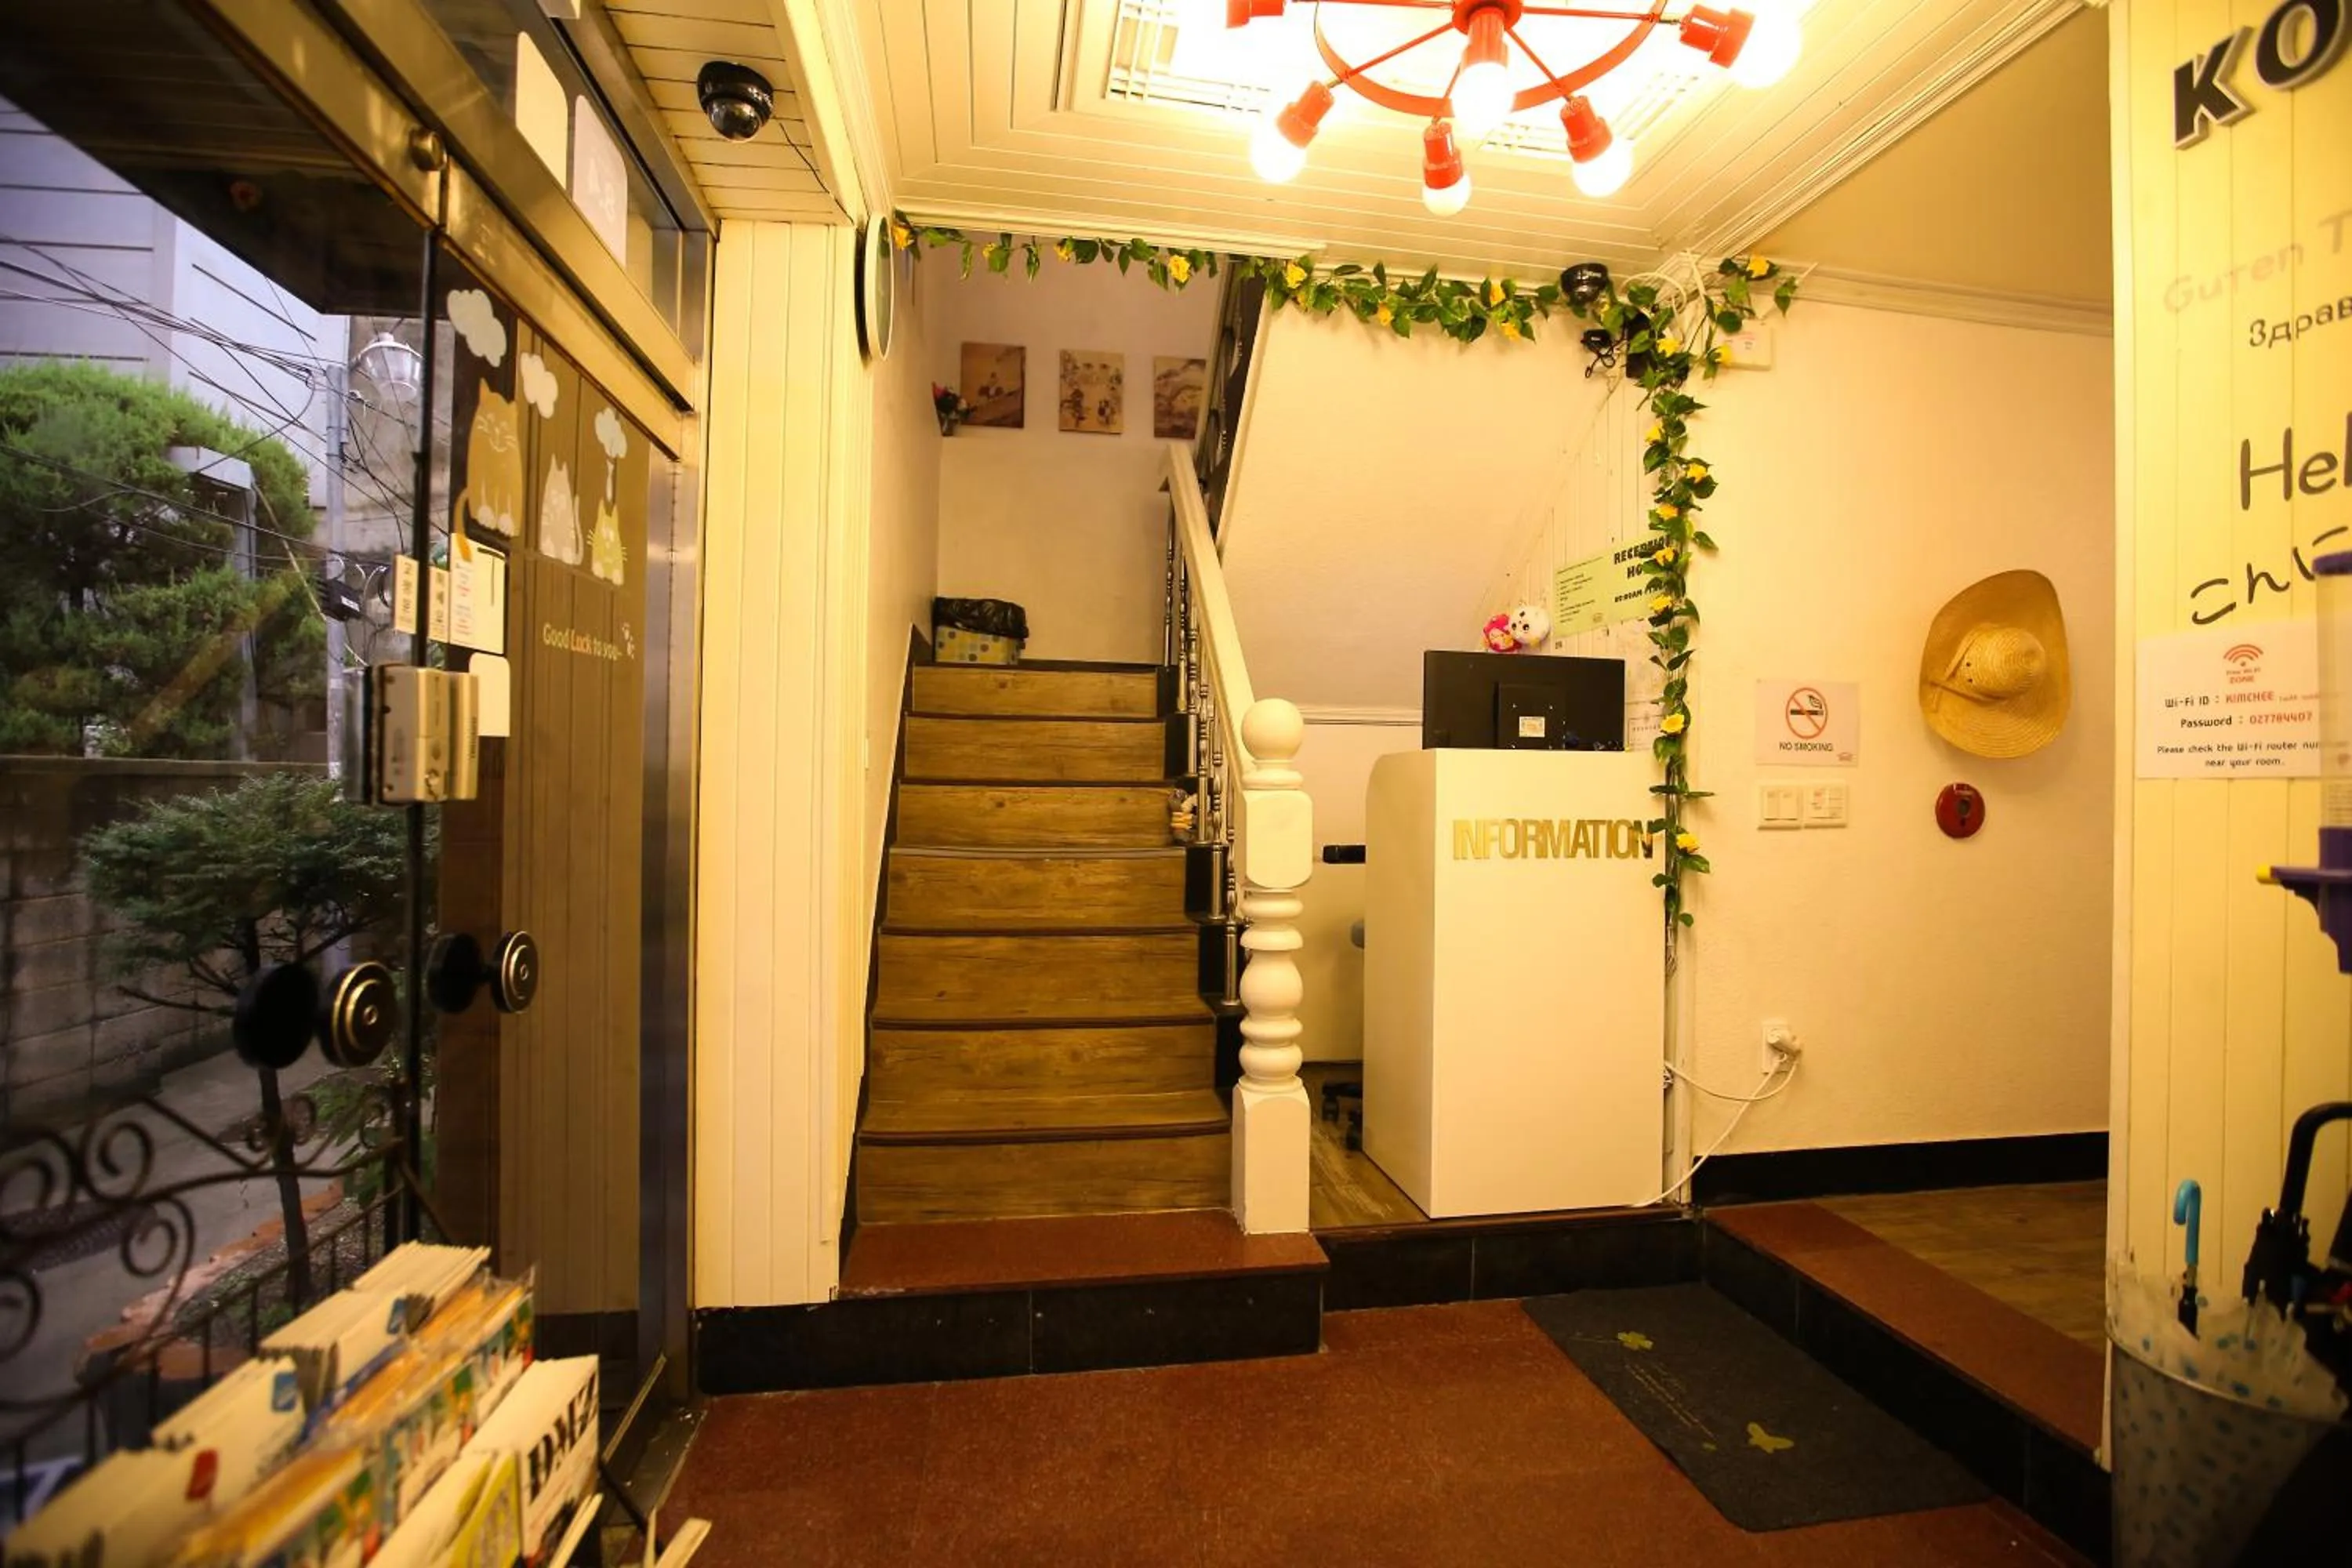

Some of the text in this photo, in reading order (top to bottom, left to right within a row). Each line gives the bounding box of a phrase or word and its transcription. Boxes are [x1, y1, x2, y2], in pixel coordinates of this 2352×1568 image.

[543, 622, 570, 650] Good
[571, 629, 593, 655] Luck
[593, 637, 602, 657] to
[2165, 695, 2194, 708] Wi-Fi
[2199, 695, 2209, 706] ID
[2226, 691, 2275, 703] KIMCHEE
[2180, 714, 2233, 728] Password
[1779, 741, 1834, 753] NO SMOKING
[2157, 745, 2185, 754] Please
[2188, 743, 2213, 753] check
[2216, 742, 2234, 752] the
[2267, 741, 2298, 750] router
[2229, 758, 2252, 769] your
[1452, 818, 1654, 861] INFORMATION
